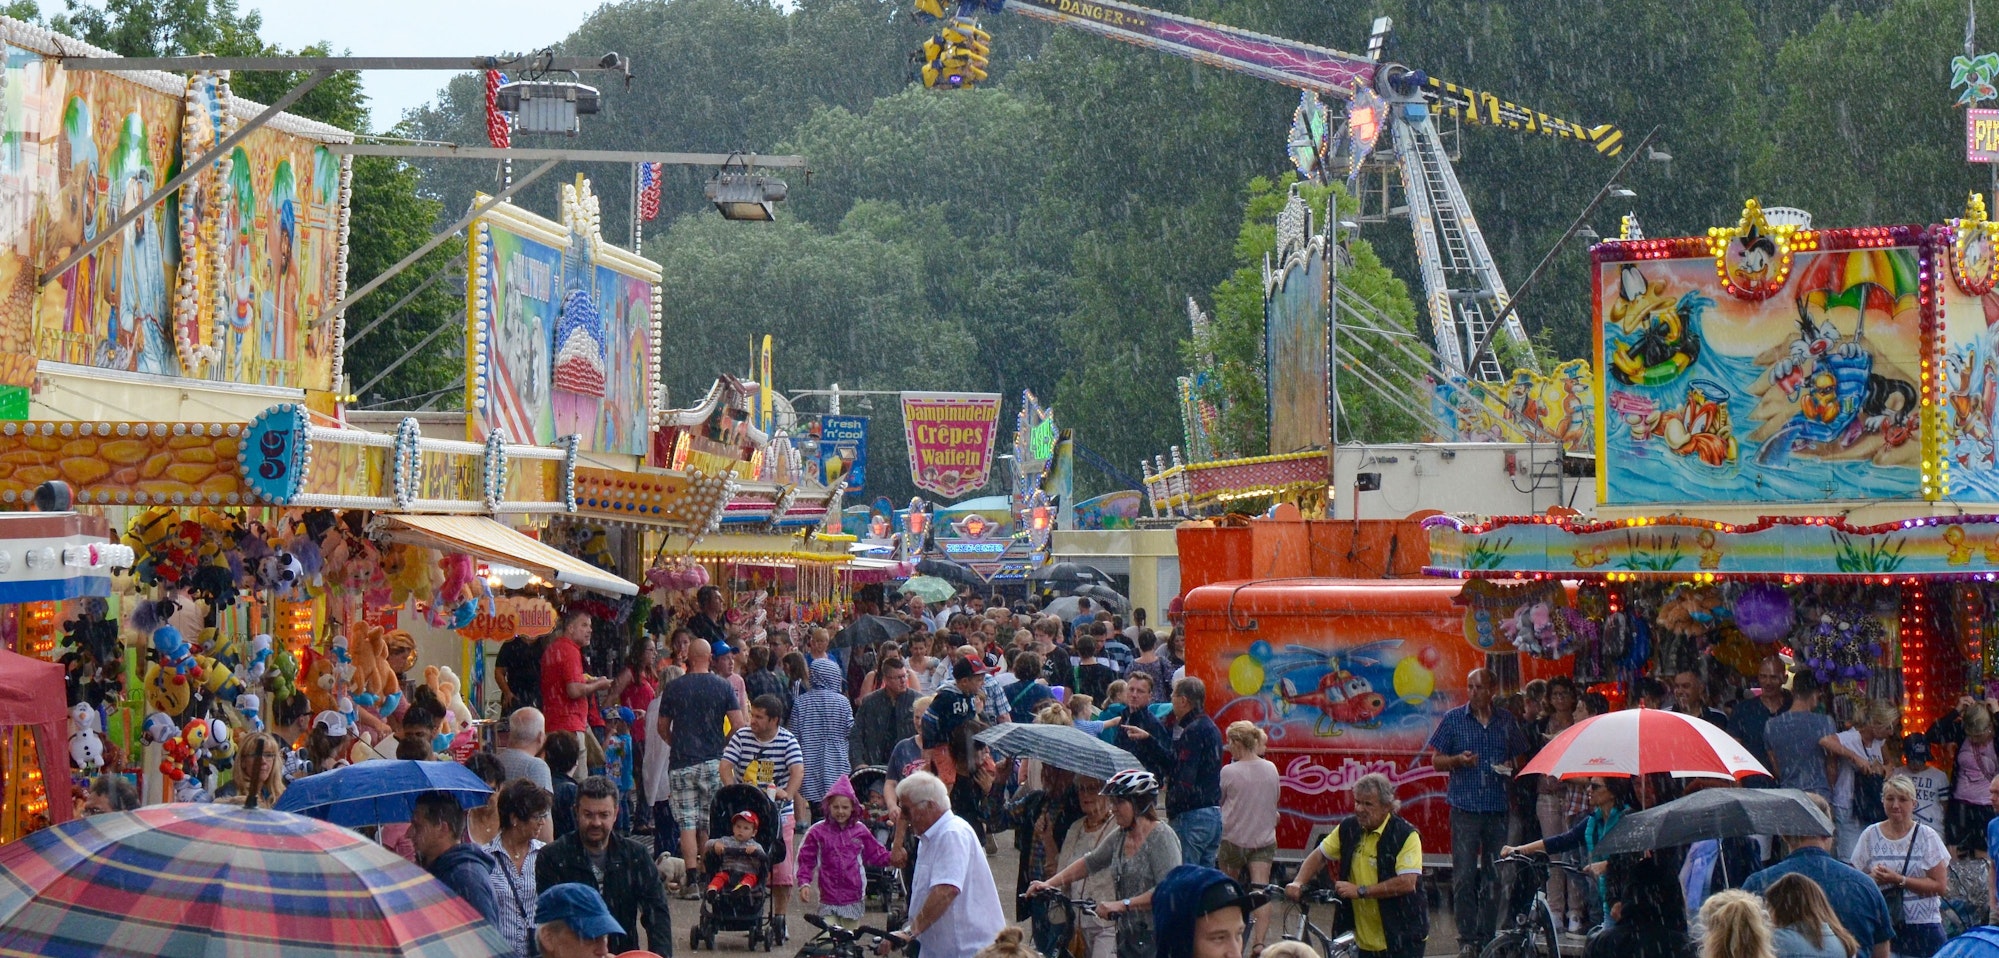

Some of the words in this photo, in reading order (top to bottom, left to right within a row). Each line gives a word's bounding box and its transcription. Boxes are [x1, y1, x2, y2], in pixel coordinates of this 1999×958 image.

[828, 419, 862, 428] fresh
[917, 424, 983, 447] Crêpes
[921, 449, 981, 466] Waffeln
